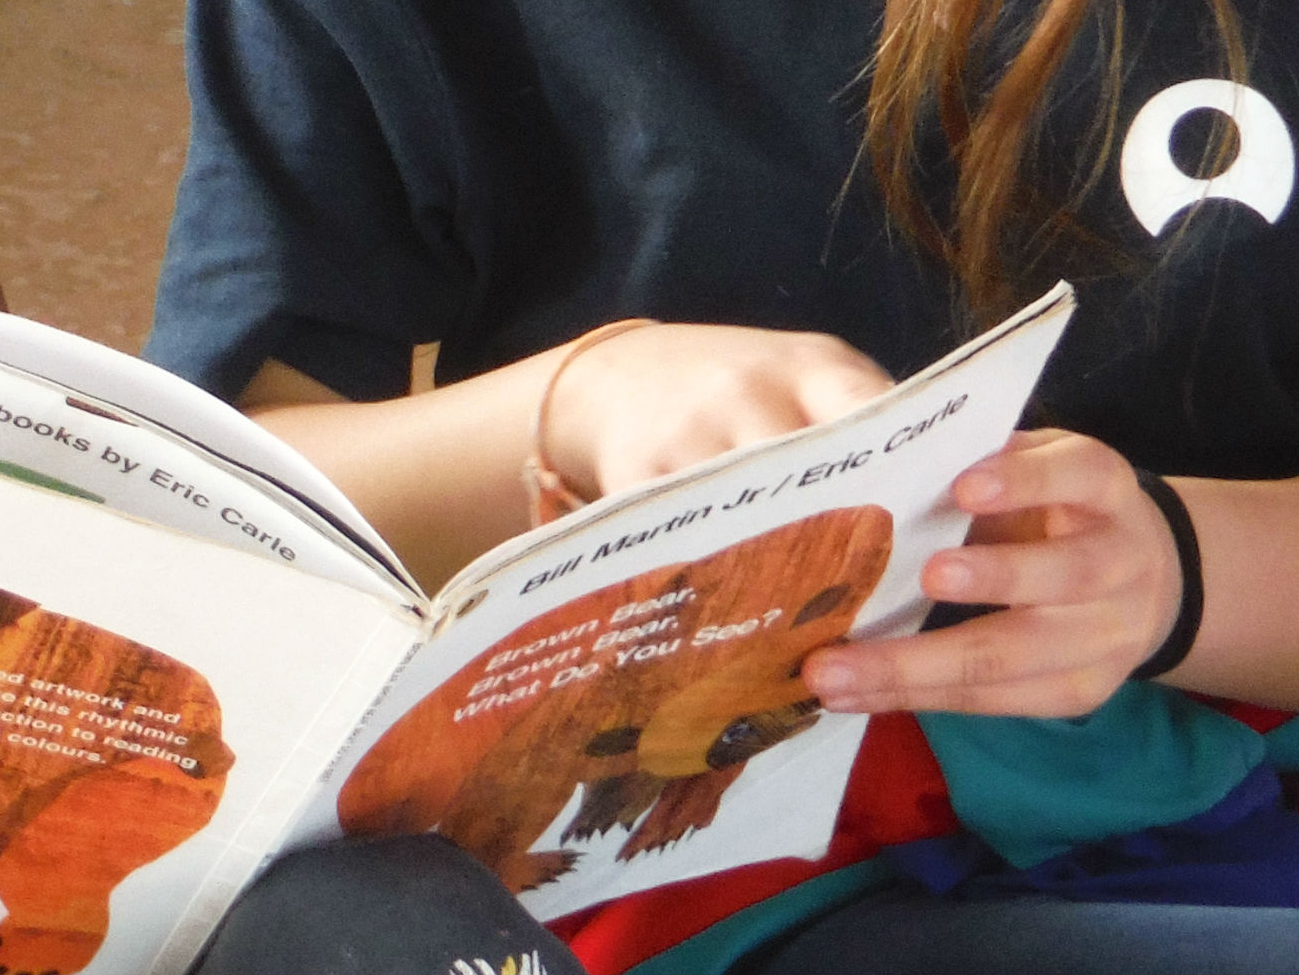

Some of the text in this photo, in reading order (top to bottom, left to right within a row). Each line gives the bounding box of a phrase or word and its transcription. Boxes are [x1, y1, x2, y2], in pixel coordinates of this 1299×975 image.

[100, 446, 140, 474] by
[149, 468, 210, 509] Eric
[220, 507, 297, 562] Carle
[519, 554, 583, 596] Bill
[591, 505, 713, 563] Martin
[722, 486, 768, 511] Jr
[797, 448, 873, 489] Eric
[884, 392, 971, 455] Carle
[453, 608, 783, 723] What Do You See?
[466, 615, 679, 698] Brown Bear,
[484, 587, 697, 672] Brown Bear,
[23, 695, 71, 717] this
[78, 710, 189, 746] rhythmic
[30, 678, 125, 711] artwork
[133, 704, 182, 725] and
[7, 733, 108, 765] colours.
[71, 727, 96, 742] to
[103, 735, 199, 770] reading
